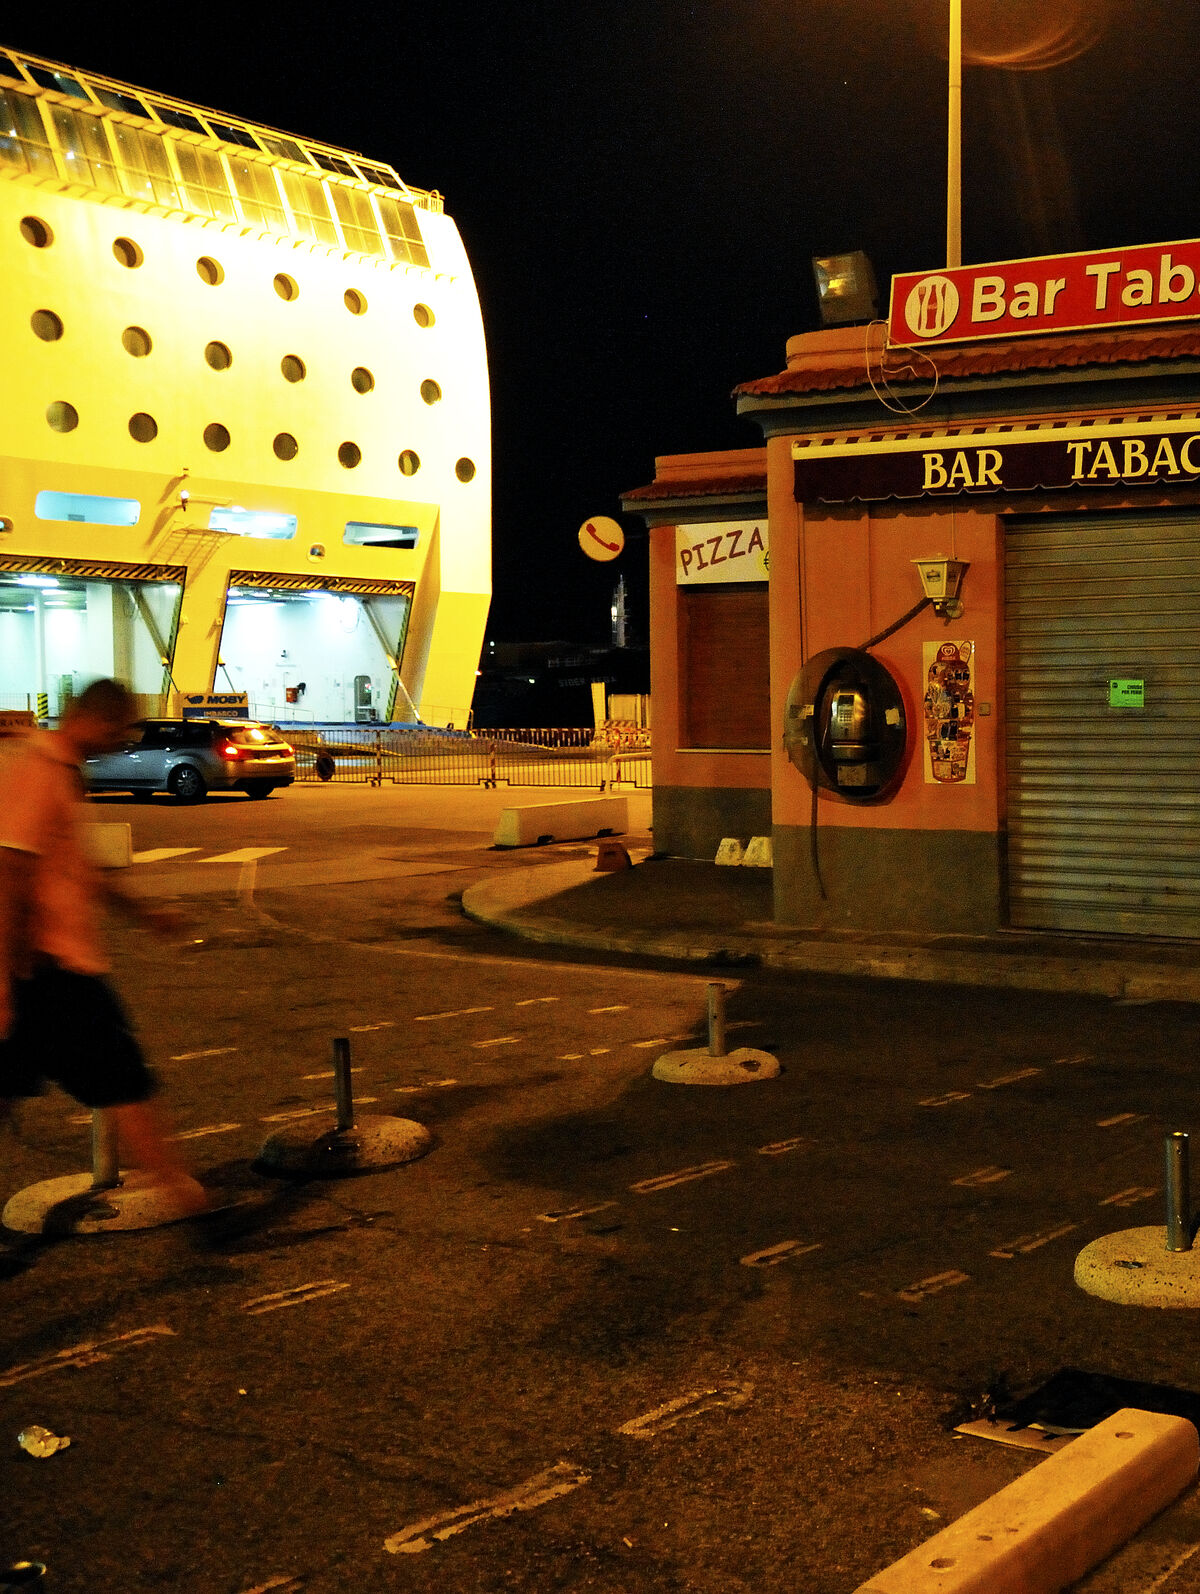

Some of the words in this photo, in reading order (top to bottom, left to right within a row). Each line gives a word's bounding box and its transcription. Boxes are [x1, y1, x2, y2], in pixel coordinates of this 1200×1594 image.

[971, 275, 1065, 323] Bar
[922, 449, 1003, 490] BAR
[680, 527, 764, 576] PIZZA
[207, 695, 246, 704] MOBY
